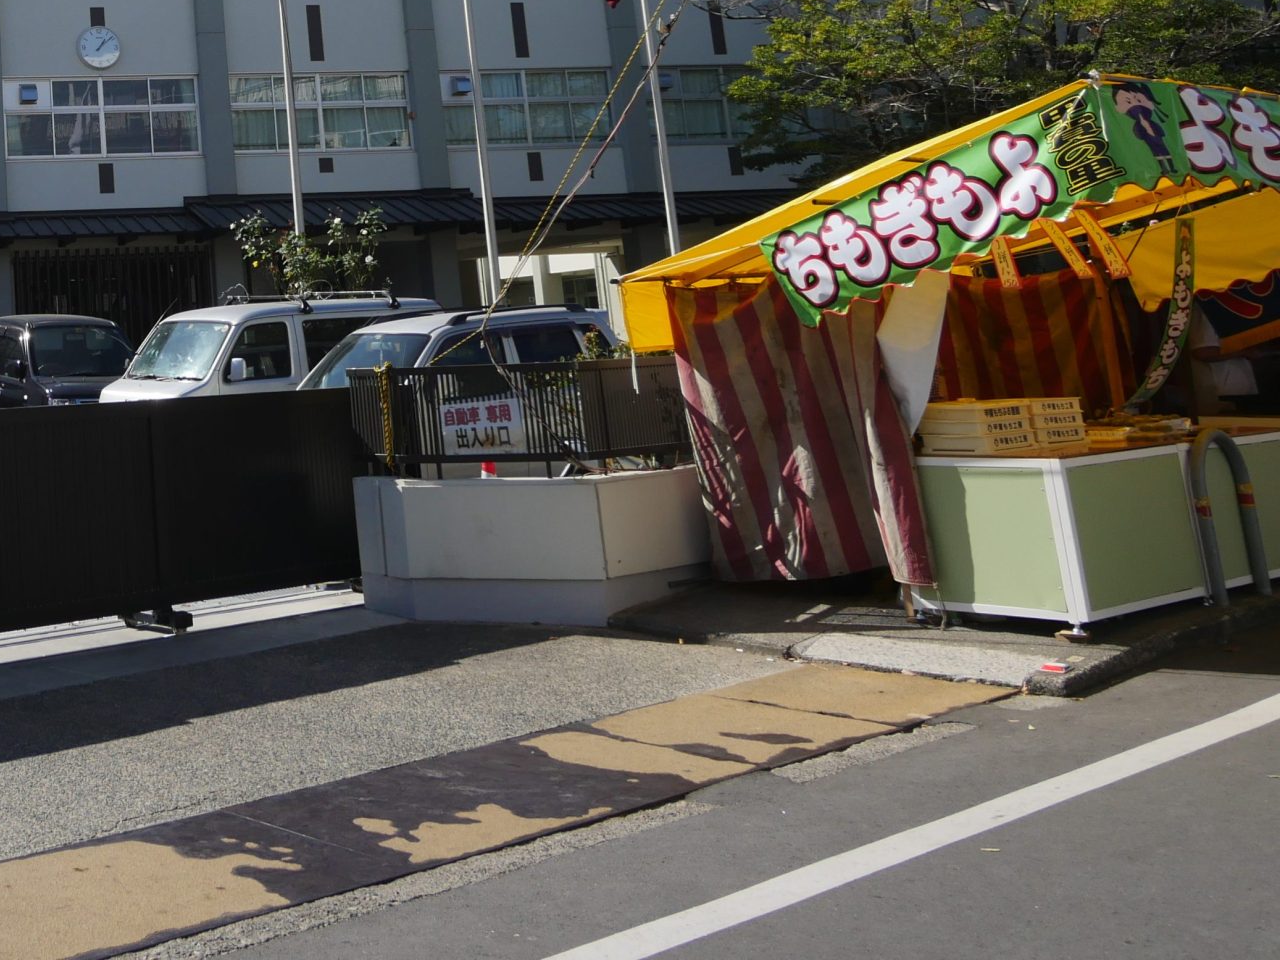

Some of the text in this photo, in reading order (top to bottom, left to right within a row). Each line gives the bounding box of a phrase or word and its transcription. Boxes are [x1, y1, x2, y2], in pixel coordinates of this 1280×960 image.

[1146, 250, 1192, 390] よもぎもち
[444, 403, 512, 426] 自動車 専用
[455, 426, 512, 448] 出入り口
